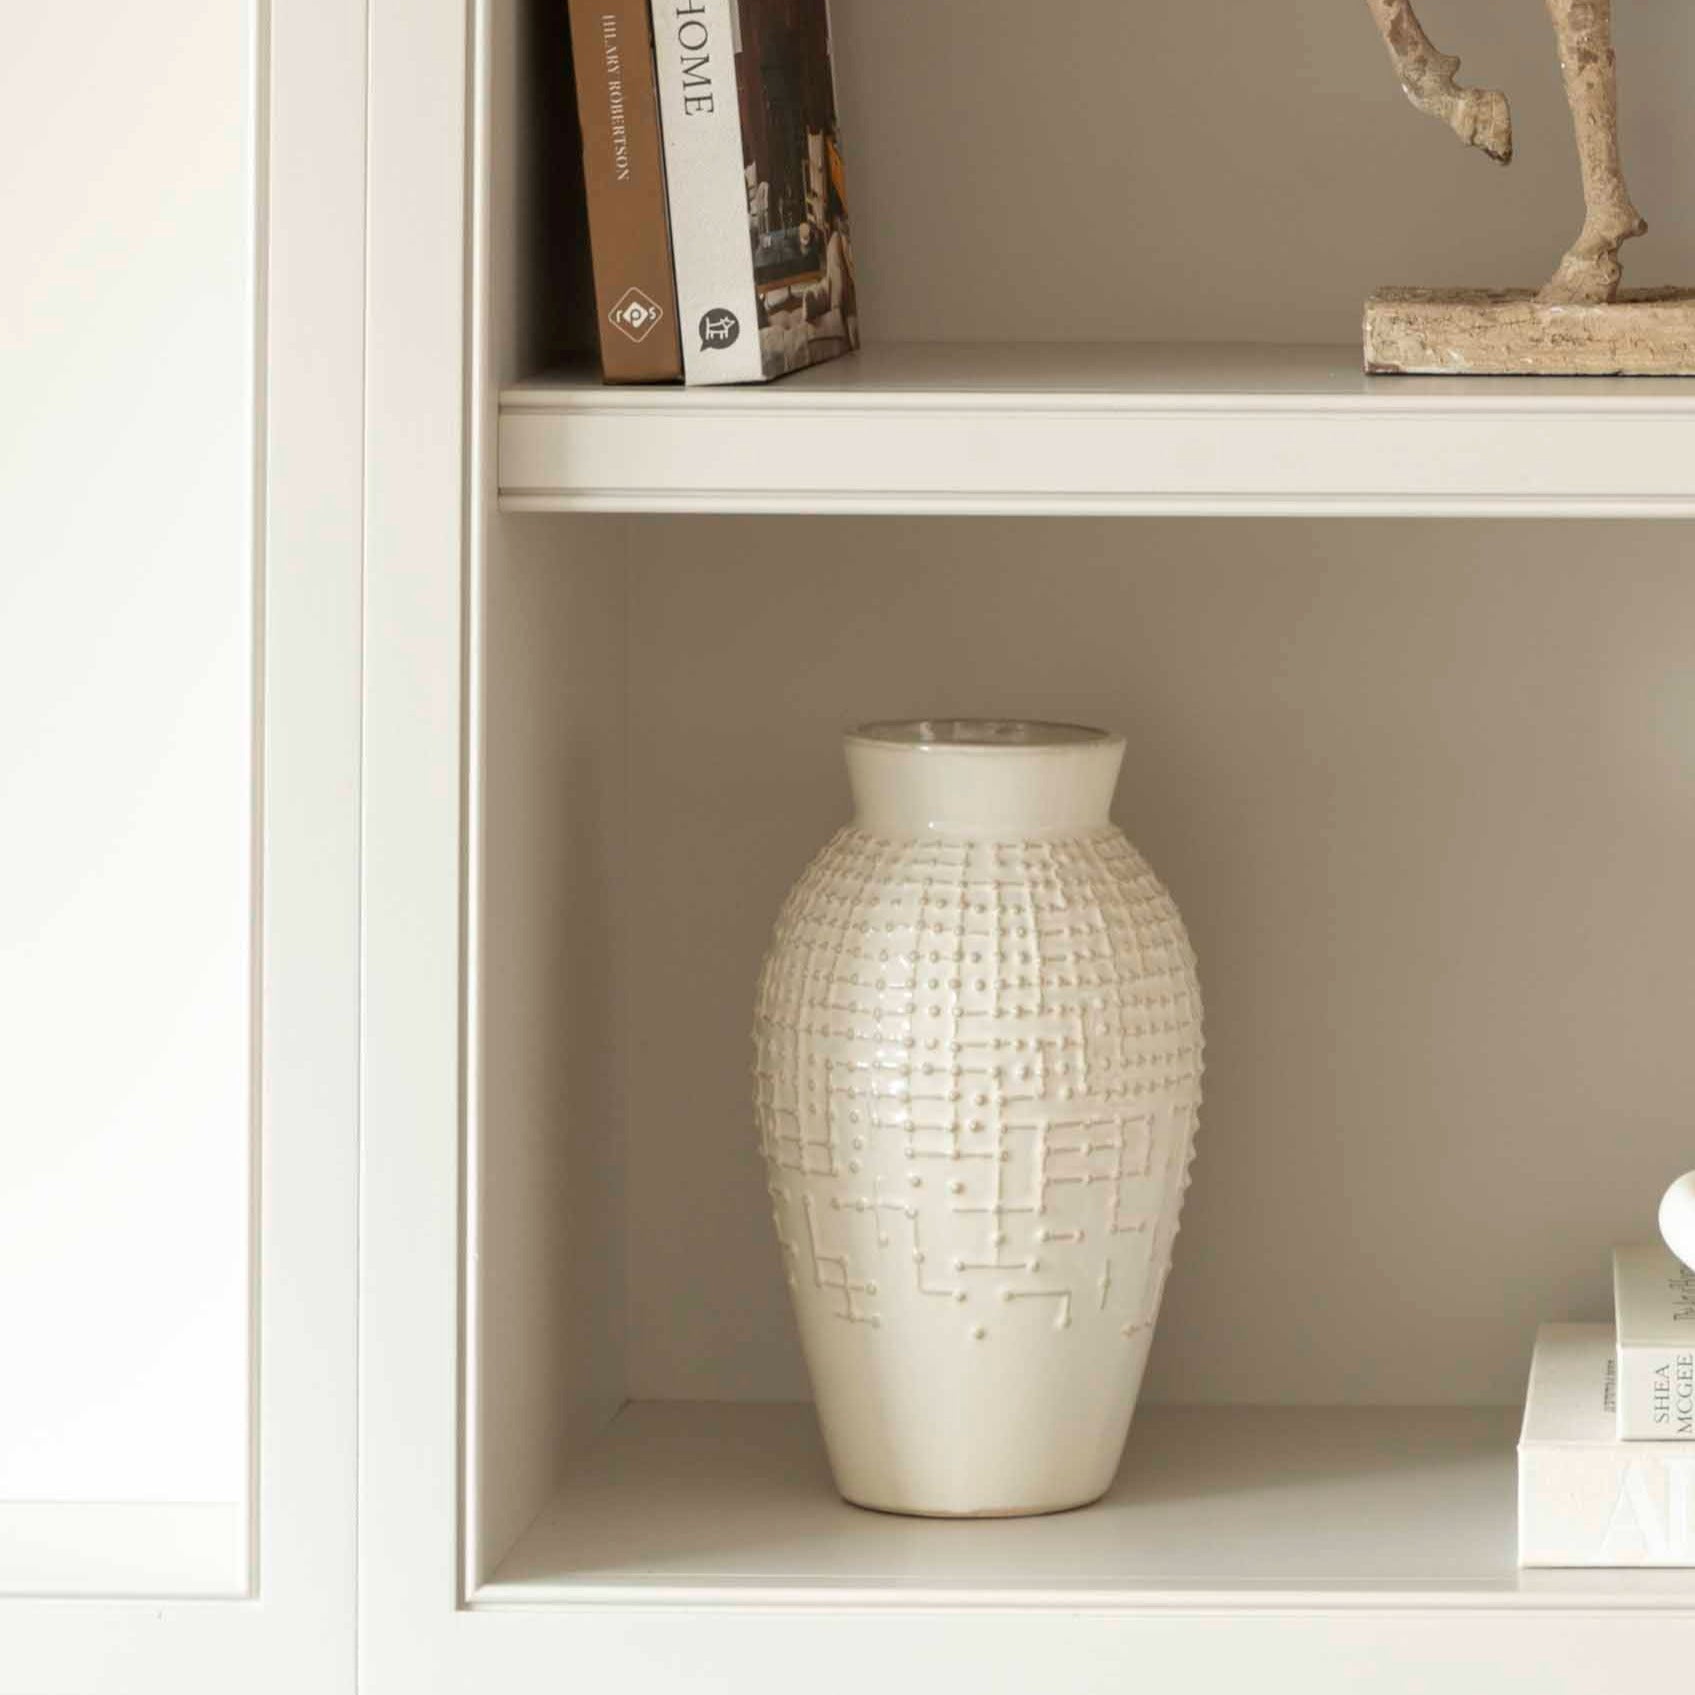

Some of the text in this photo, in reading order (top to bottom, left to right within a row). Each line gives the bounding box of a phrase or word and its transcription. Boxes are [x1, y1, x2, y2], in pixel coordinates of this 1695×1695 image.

[601, 14, 631, 181] HILARY ROBERTSON
[1655, 1364, 1671, 1424] SHEA
[1676, 1353, 1694, 1435] MCGEE
